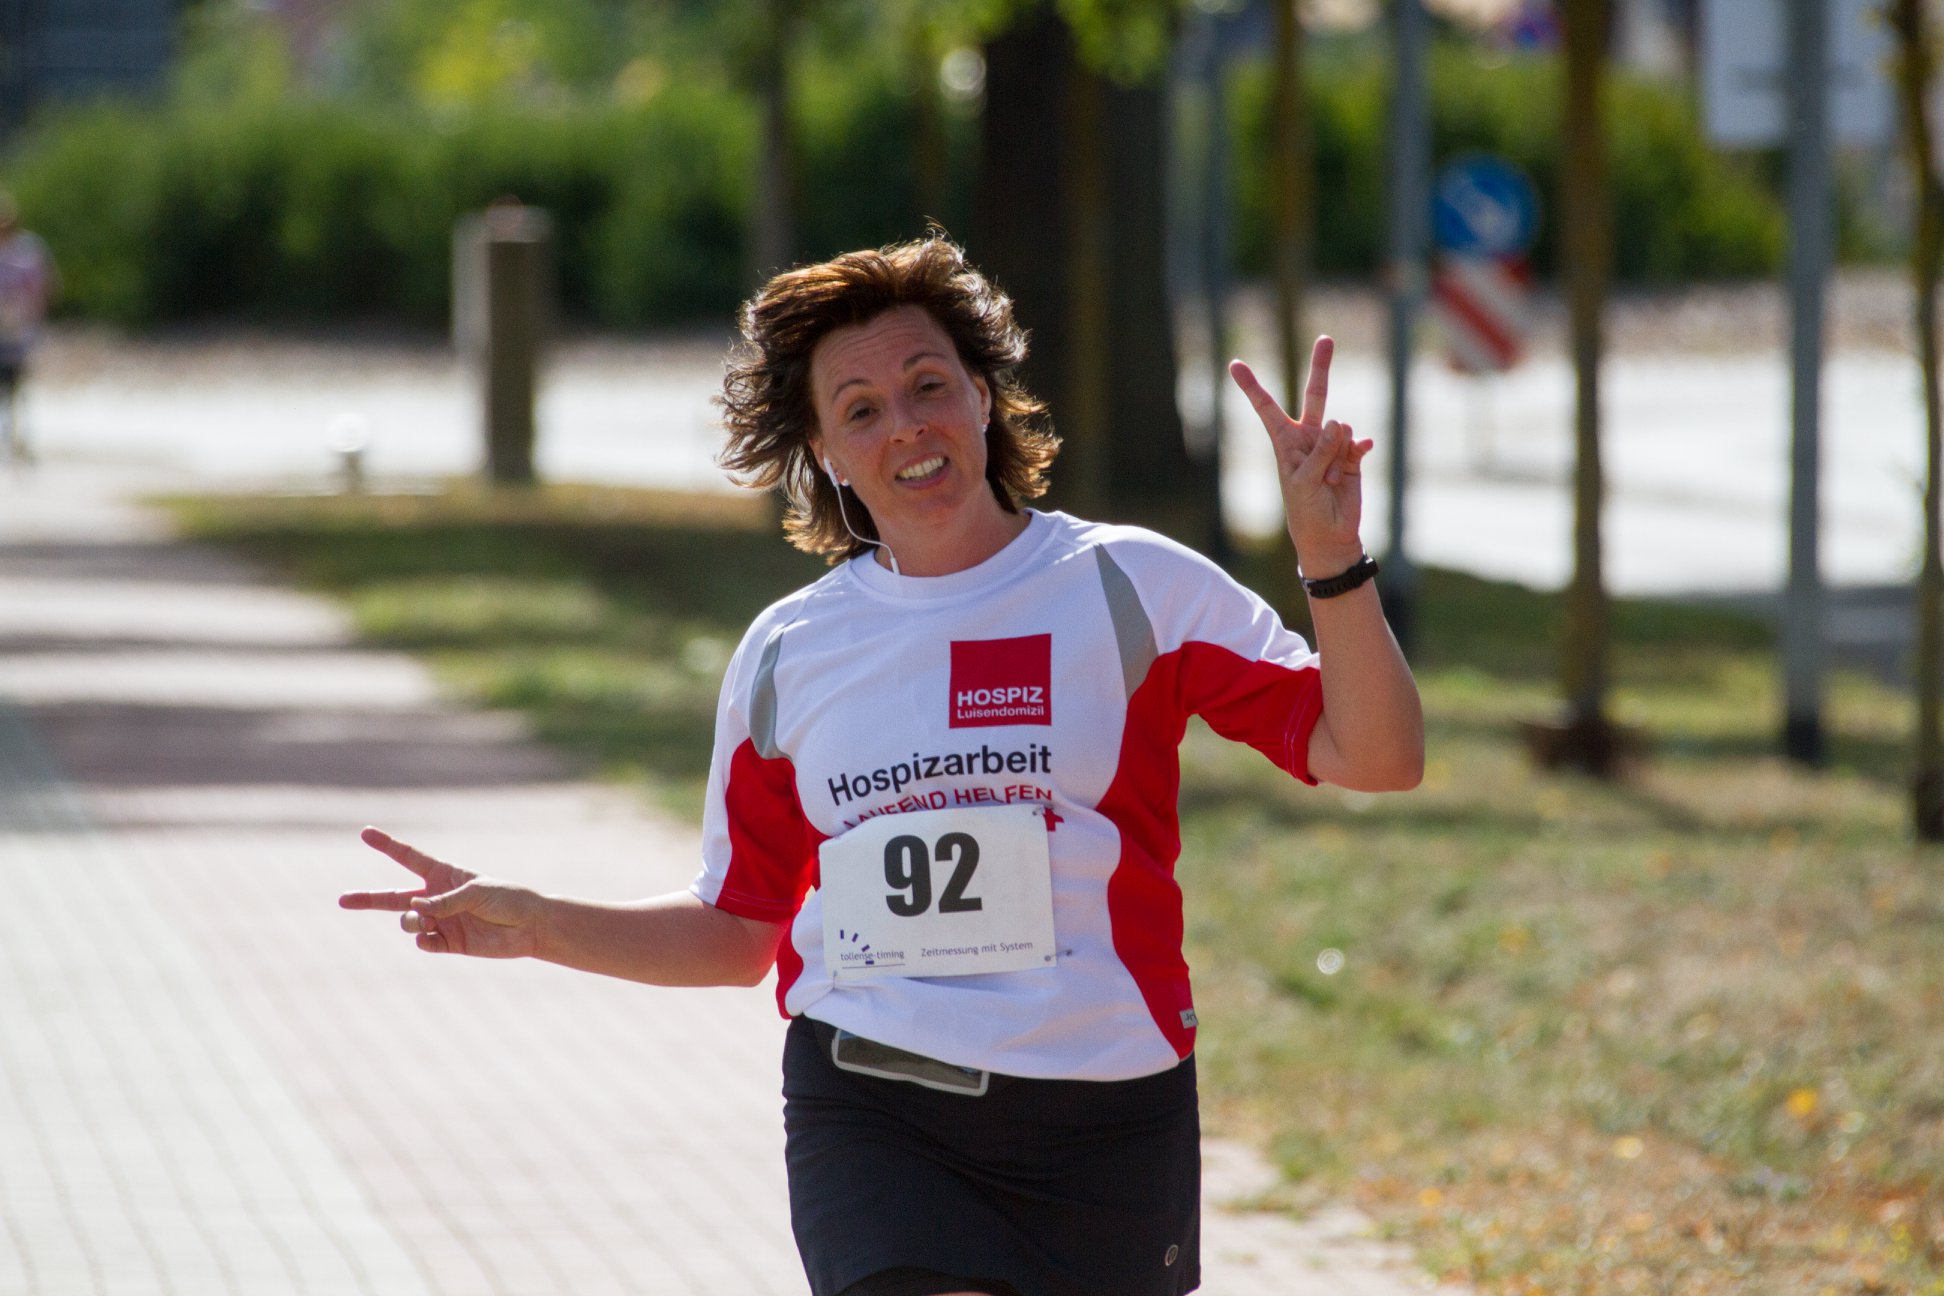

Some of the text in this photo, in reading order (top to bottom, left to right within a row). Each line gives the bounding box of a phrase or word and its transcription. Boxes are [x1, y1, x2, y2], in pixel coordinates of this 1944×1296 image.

[957, 686, 1044, 707] HOSPIZ
[957, 704, 1044, 719] Luisendomizil
[828, 743, 1052, 806] Hospizarbeit
[954, 784, 1052, 804] HELFEN
[884, 832, 983, 917] 92
[921, 941, 1033, 957] Zeitmessung mit System
